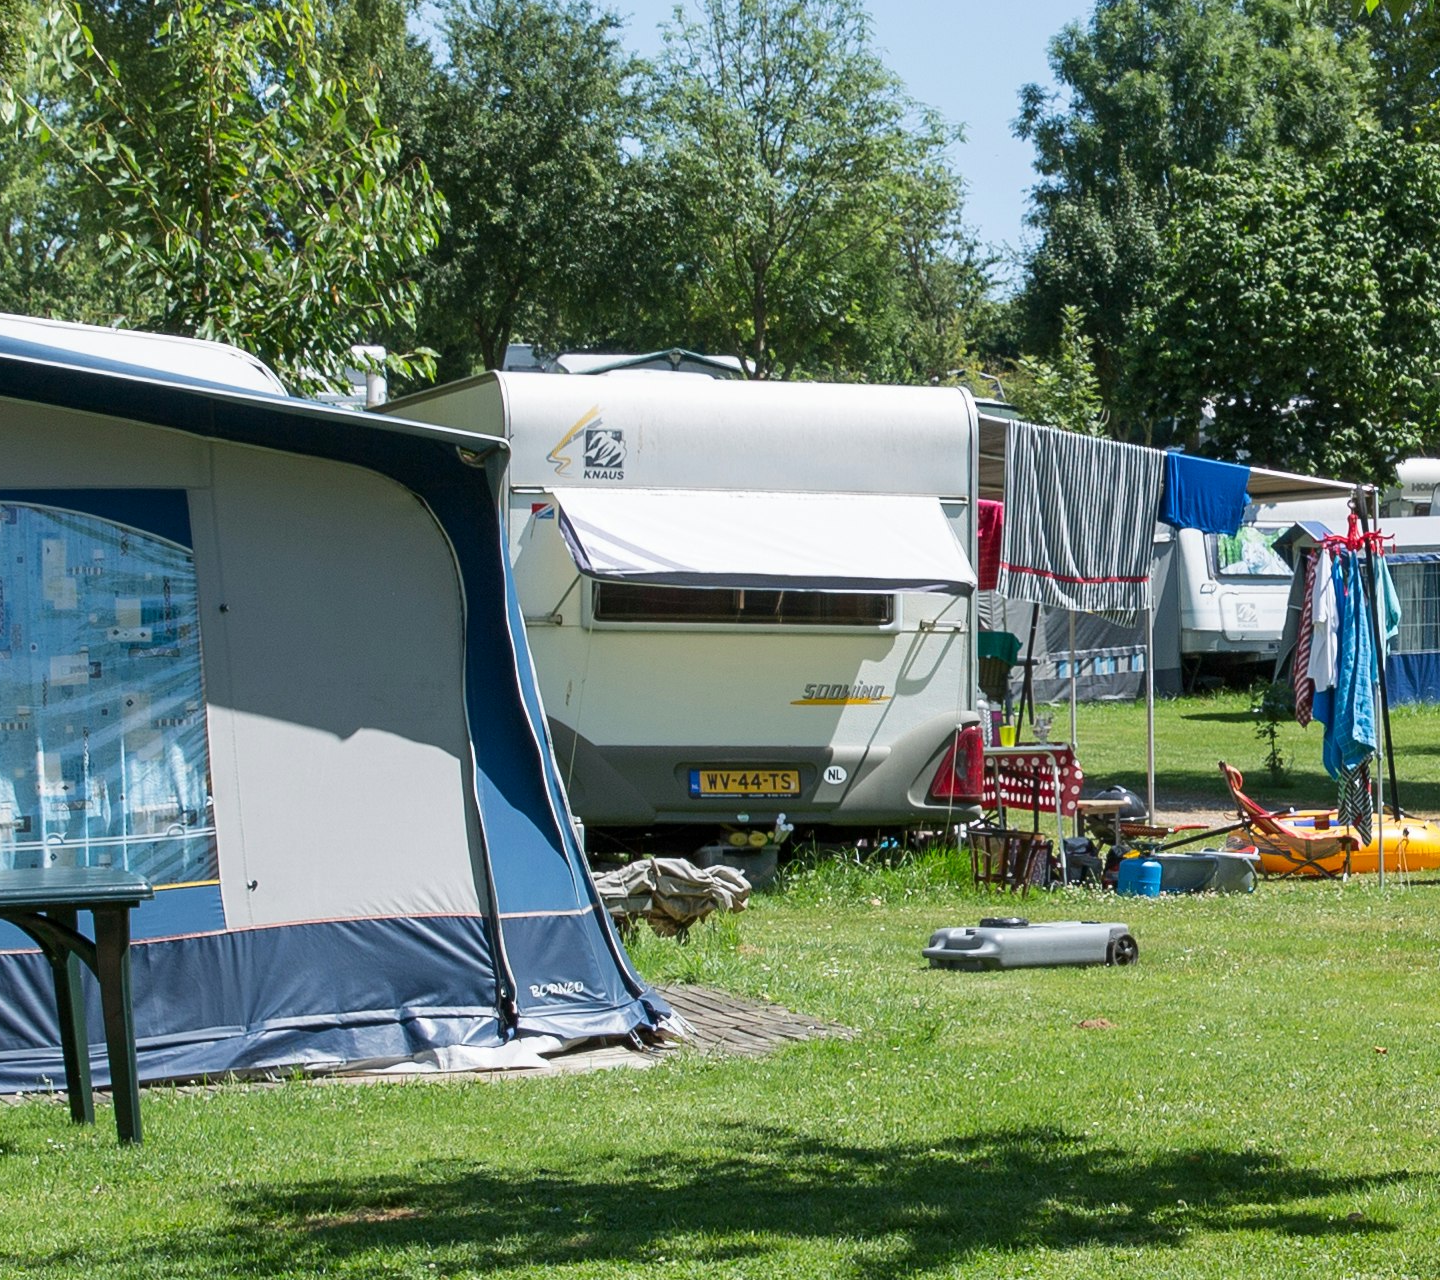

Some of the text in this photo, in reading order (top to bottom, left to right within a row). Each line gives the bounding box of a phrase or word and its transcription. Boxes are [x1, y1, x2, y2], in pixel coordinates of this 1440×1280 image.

[583, 469, 625, 481] KNAUS
[706, 773, 792, 790] WV-44-TS
[827, 768, 842, 781] NL
[529, 980, 585, 998] BORNEO
